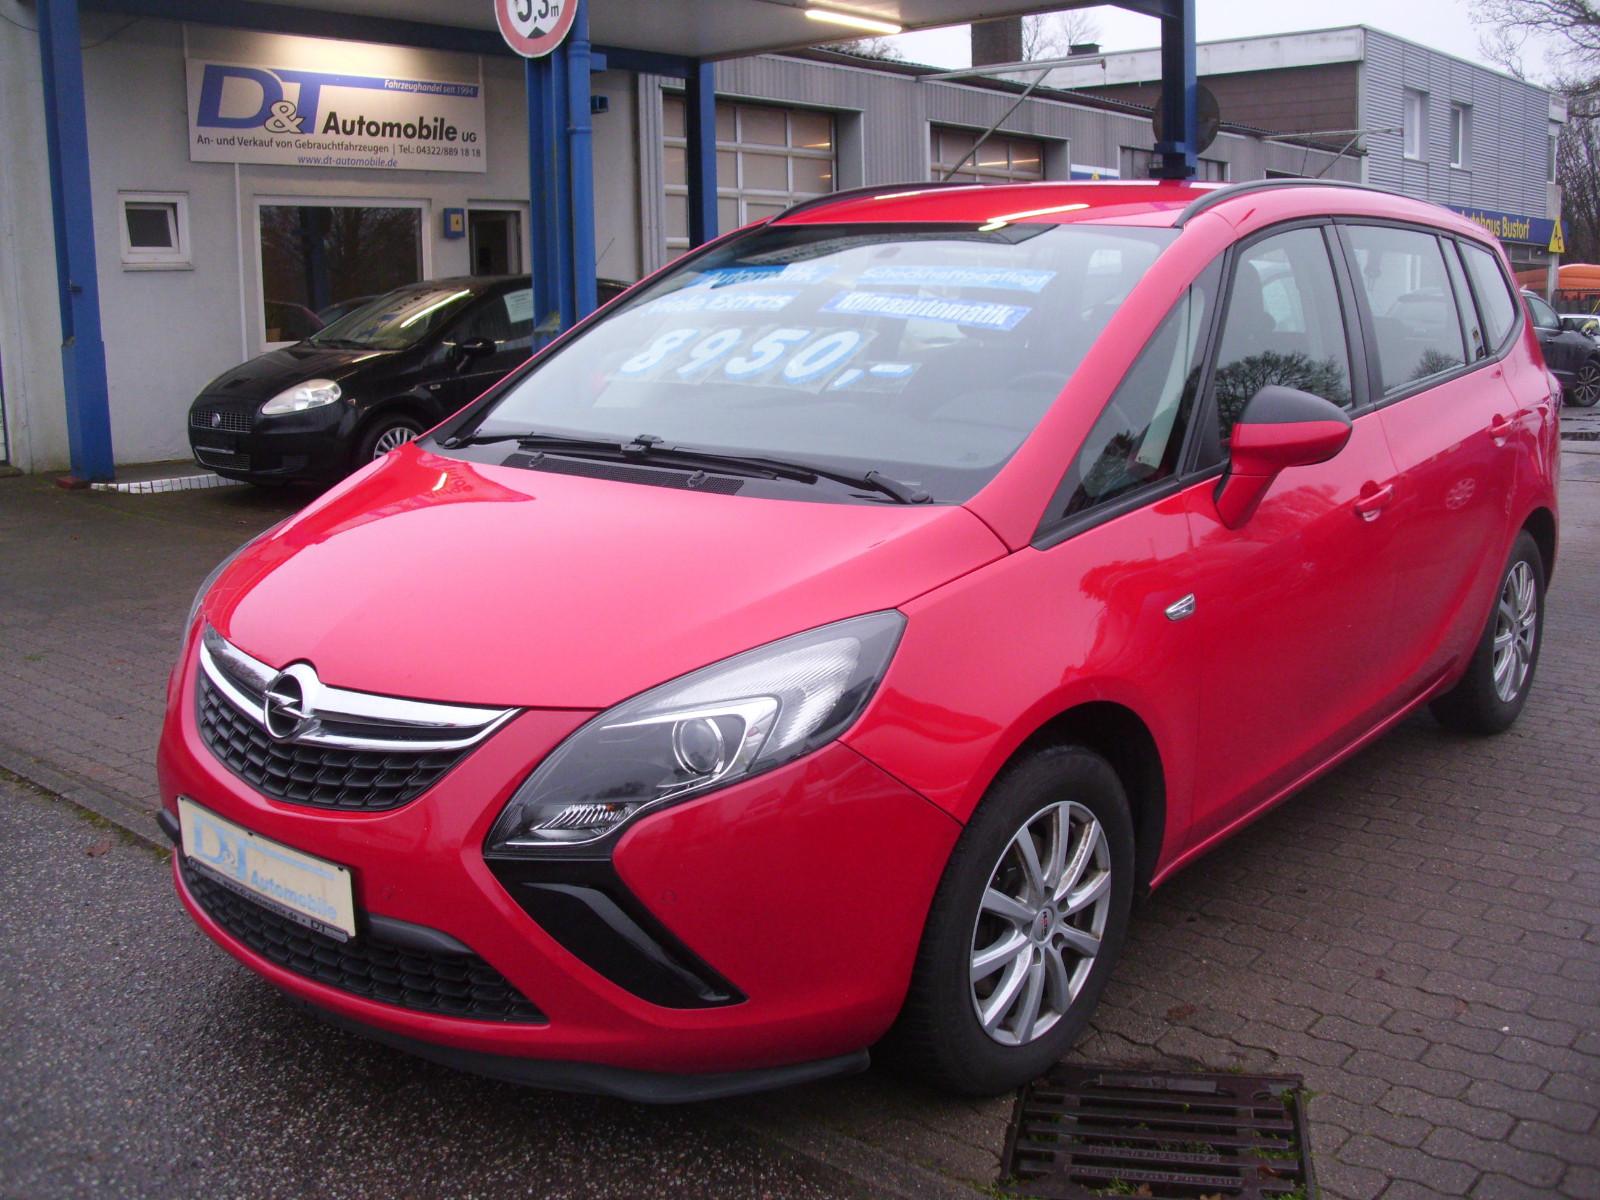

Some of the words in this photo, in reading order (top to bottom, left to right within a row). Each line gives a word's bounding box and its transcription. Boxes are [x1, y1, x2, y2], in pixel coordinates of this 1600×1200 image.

[384, 80, 442, 93] Fahrzeughandel
[442, 84, 457, 94] seit
[322, 112, 458, 141] Automobile
[461, 131, 477, 143] UG
[197, 134, 214, 145] An-
[216, 135, 235, 147] und
[237, 136, 273, 148] Verkauf
[275, 139, 293, 149] von
[295, 140, 389, 154] Gebrauchtfahrzeugen
[297, 155, 398, 168] www.dt-automobile.de
[1502, 215, 1530, 239] Bustorf
